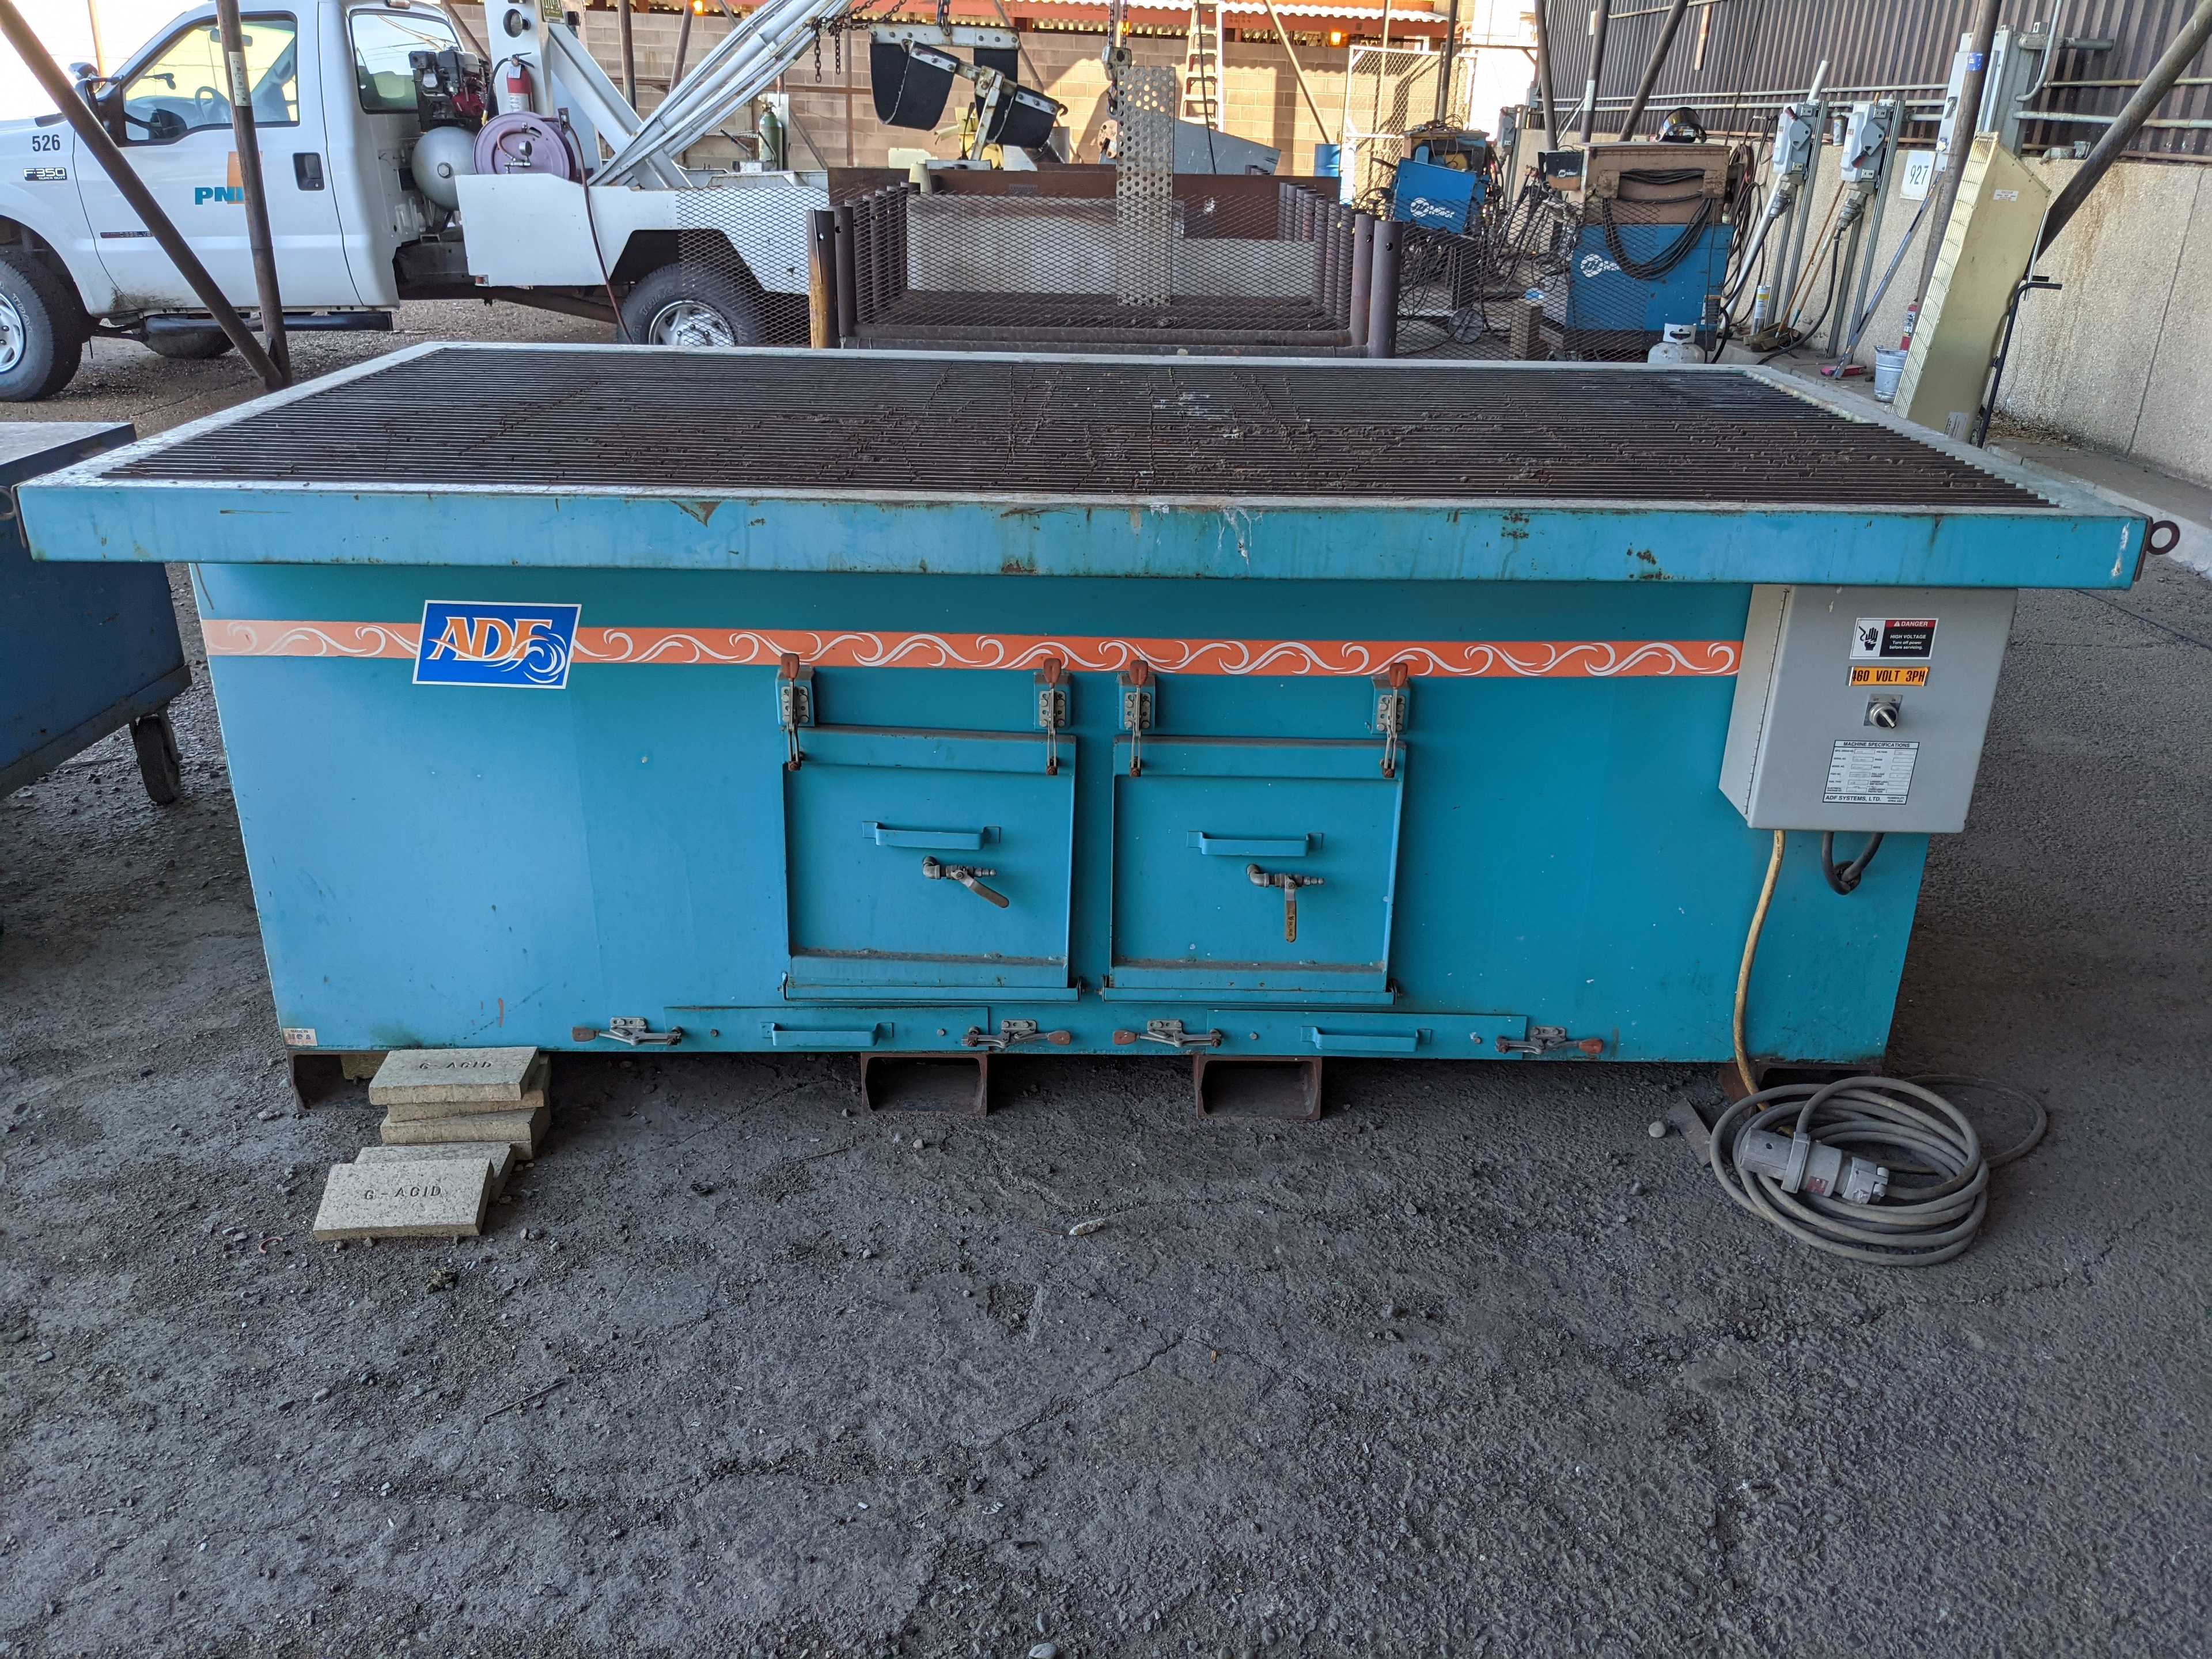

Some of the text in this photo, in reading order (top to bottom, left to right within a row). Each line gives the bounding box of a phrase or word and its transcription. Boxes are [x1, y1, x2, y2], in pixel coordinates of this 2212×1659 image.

[32, 134, 60, 152] 526
[1910, 164, 1929, 185] 927
[425, 616, 553, 662] ADF
[1876, 670, 1901, 682] VOLT
[1905, 670, 1926, 683] 3PH
